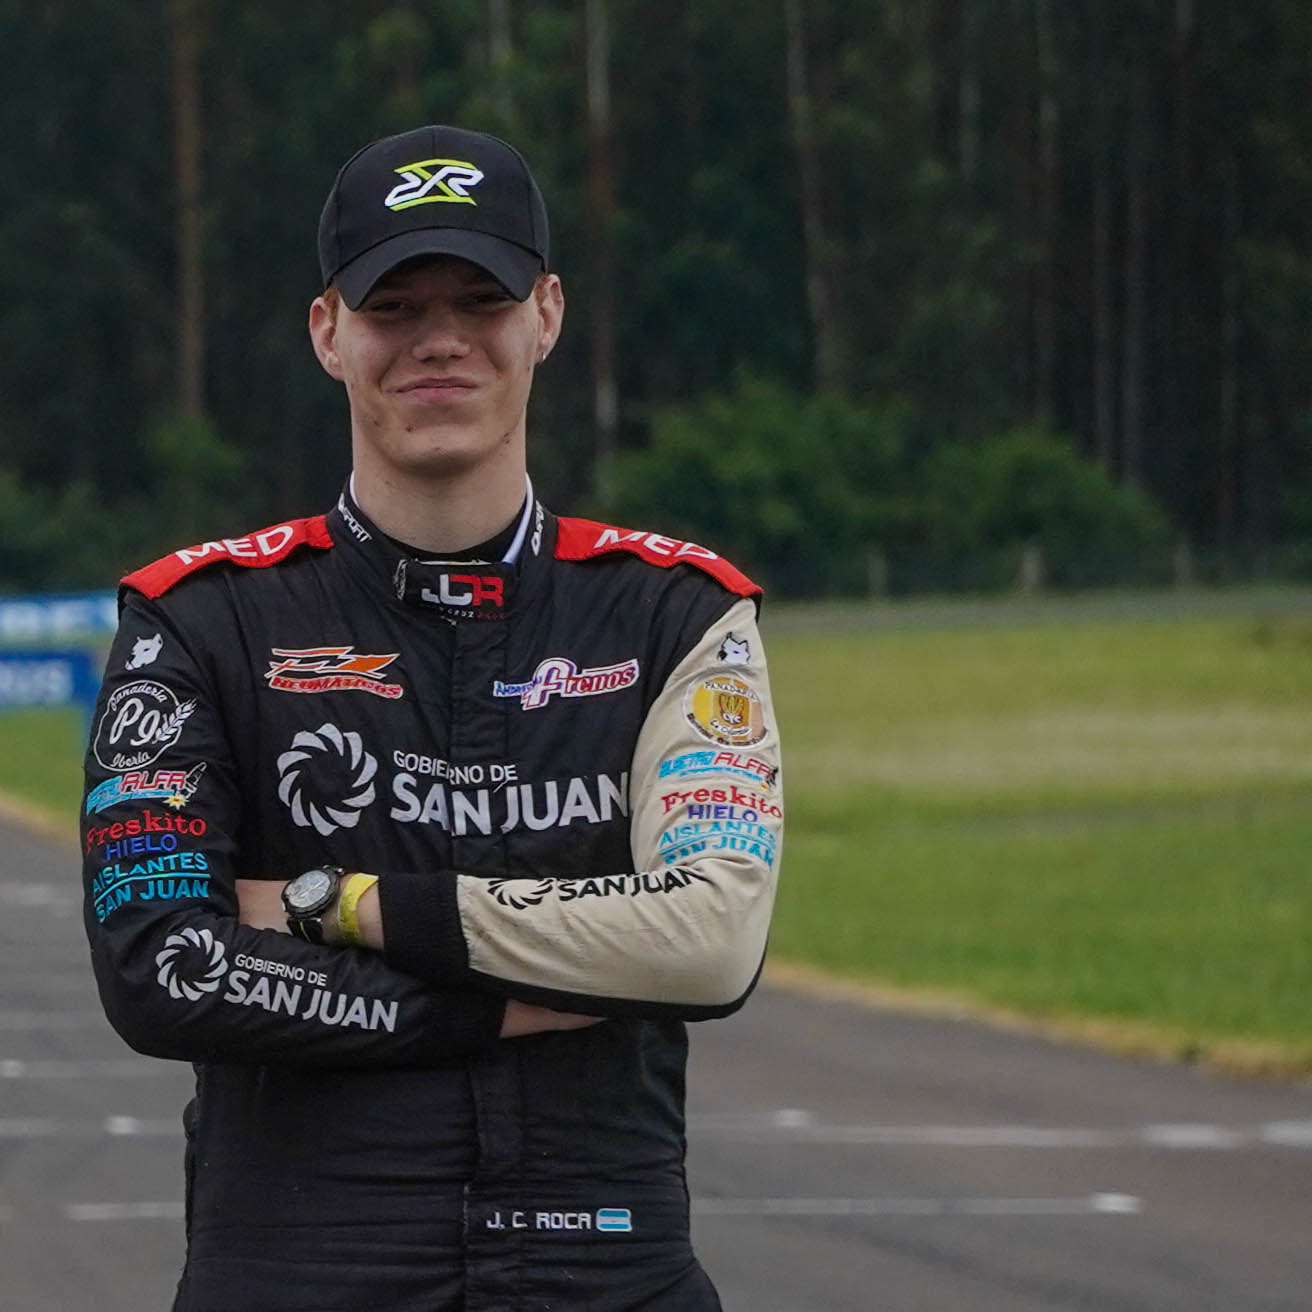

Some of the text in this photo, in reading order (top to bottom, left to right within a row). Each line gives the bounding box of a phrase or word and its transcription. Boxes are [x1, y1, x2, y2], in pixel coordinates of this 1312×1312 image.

[176, 525, 294, 566] MED
[593, 528, 719, 561] MED
[393, 750, 518, 785] GOBIERNO DE
[390, 771, 628, 837] SAN JUAN
[661, 786, 783, 819] Freskito
[688, 804, 758, 822] HIELO
[105, 833, 177, 861] HIELO
[92, 851, 208, 894] AISLANTES
[558, 876, 626, 901] SAN
[95, 879, 209, 923] SAN JUAN
[235, 953, 328, 987] GOBIERNO DE
[224, 970, 399, 1033] SAN JUAN
[486, 1212, 504, 1229] J.
[536, 1212, 592, 1230] ROCA
